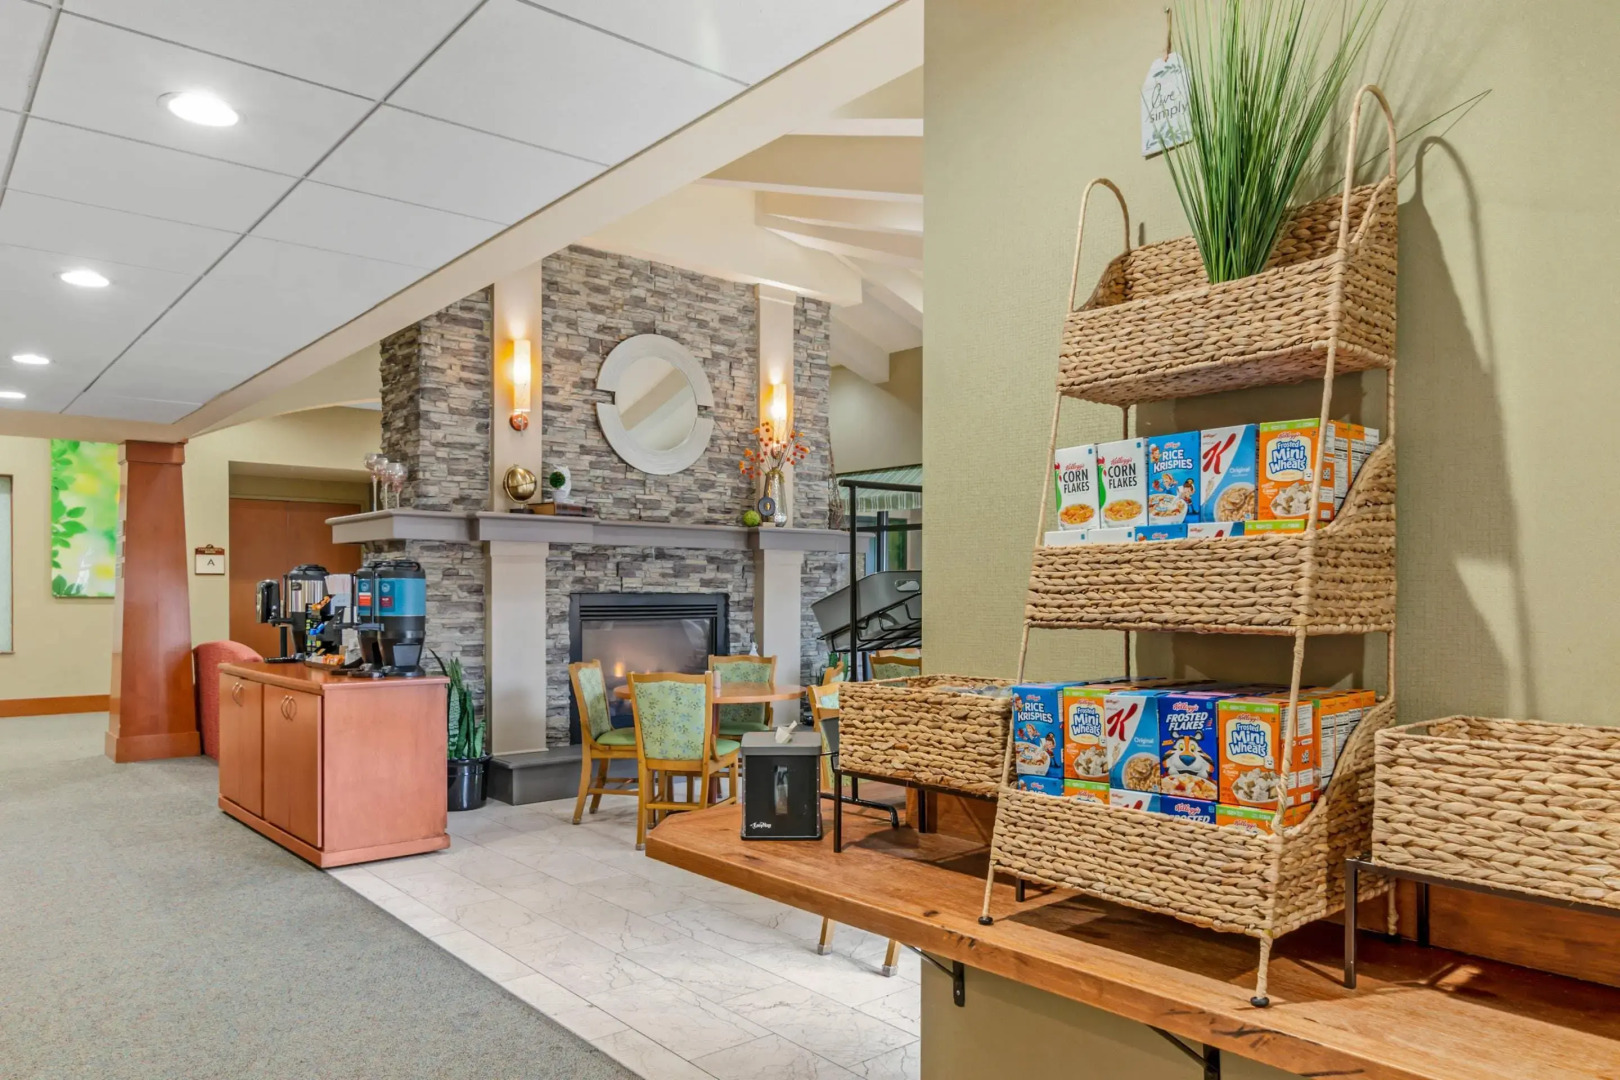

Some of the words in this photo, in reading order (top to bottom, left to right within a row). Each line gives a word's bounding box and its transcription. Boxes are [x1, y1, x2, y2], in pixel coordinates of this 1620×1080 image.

[1150, 101, 1188, 123] simply
[1277, 440, 1300, 449] Frosted
[1162, 450, 1184, 461] RICE
[1202, 433, 1237, 474] K
[1272, 446, 1305, 462] Mini
[1108, 463, 1136, 478] CORN
[1154, 459, 1193, 473] KRISPIES
[1270, 457, 1307, 474] Wheats
[1063, 469, 1088, 483] CORN
[1109, 476, 1137, 489] FLAKES
[1064, 481, 1090, 494] FLAKES
[1025, 703, 1045, 712] RICE
[1018, 712, 1053, 724] KRISPIES
[1074, 714, 1099, 725] Mini
[1107, 703, 1138, 741] K
[1166, 712, 1208, 723] FROSTED
[1072, 724, 1101, 737] Wheats
[1169, 721, 1204, 731] FLAKES
[1236, 723, 1260, 732] Frosted
[1232, 730, 1265, 744] Mini
[1229, 742, 1267, 757] Wheats
